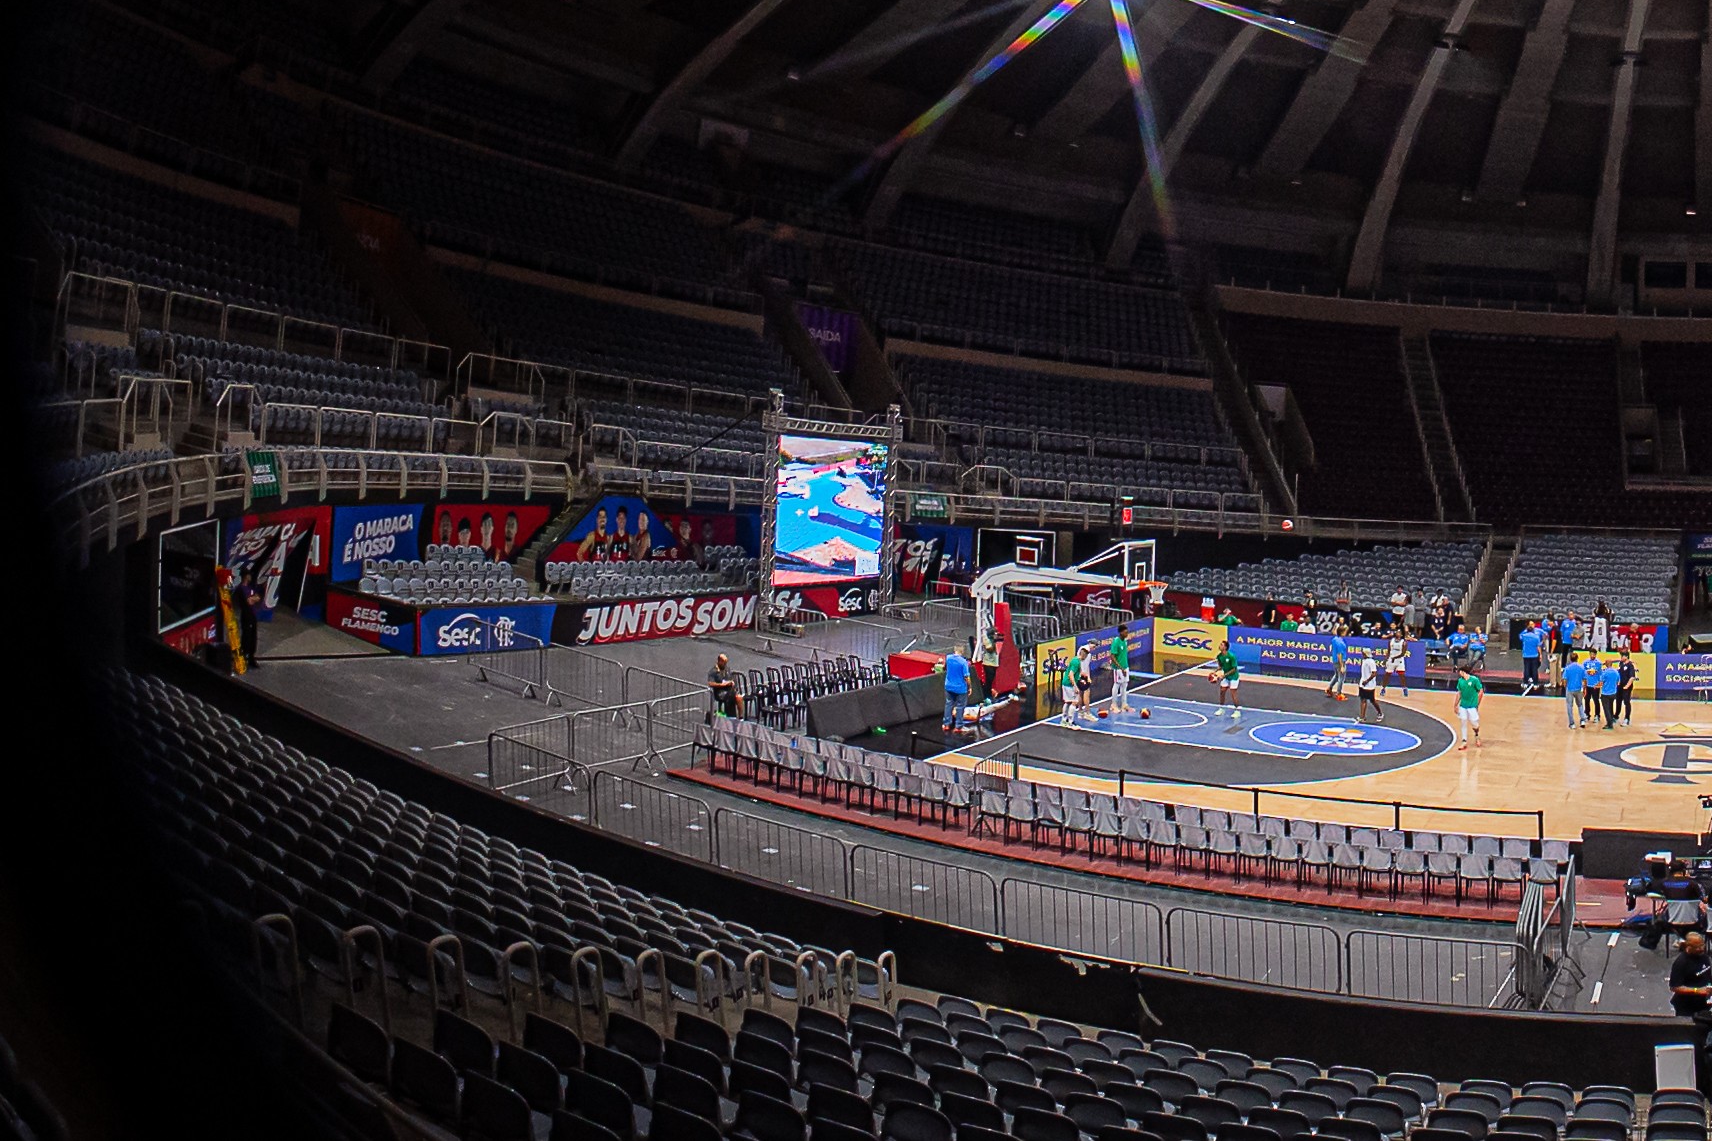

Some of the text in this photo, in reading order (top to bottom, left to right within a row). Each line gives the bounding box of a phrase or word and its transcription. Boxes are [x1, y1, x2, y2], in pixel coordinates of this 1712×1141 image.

[355, 514, 413, 540] O MARACA
[342, 538, 353, 564] É
[353, 535, 395, 560] NOSSO
[838, 592, 862, 611] Sesc
[352, 606, 388, 623] SESC
[579, 597, 693, 641] JUNTOS
[341, 617, 399, 636] FLAMENGO
[438, 619, 481, 646] Sesc
[1162, 630, 1213, 651] Sesc
[1236, 636, 1244, 644] A
[1247, 637, 1284, 647] MAIOR
[1286, 641, 1326, 652] MARCA
[1279, 651, 1296, 660] DO
[1303, 653, 1319, 662] RIO
[1665, 662, 1674, 671] A
[1665, 674, 1709, 683] SOCIAL
